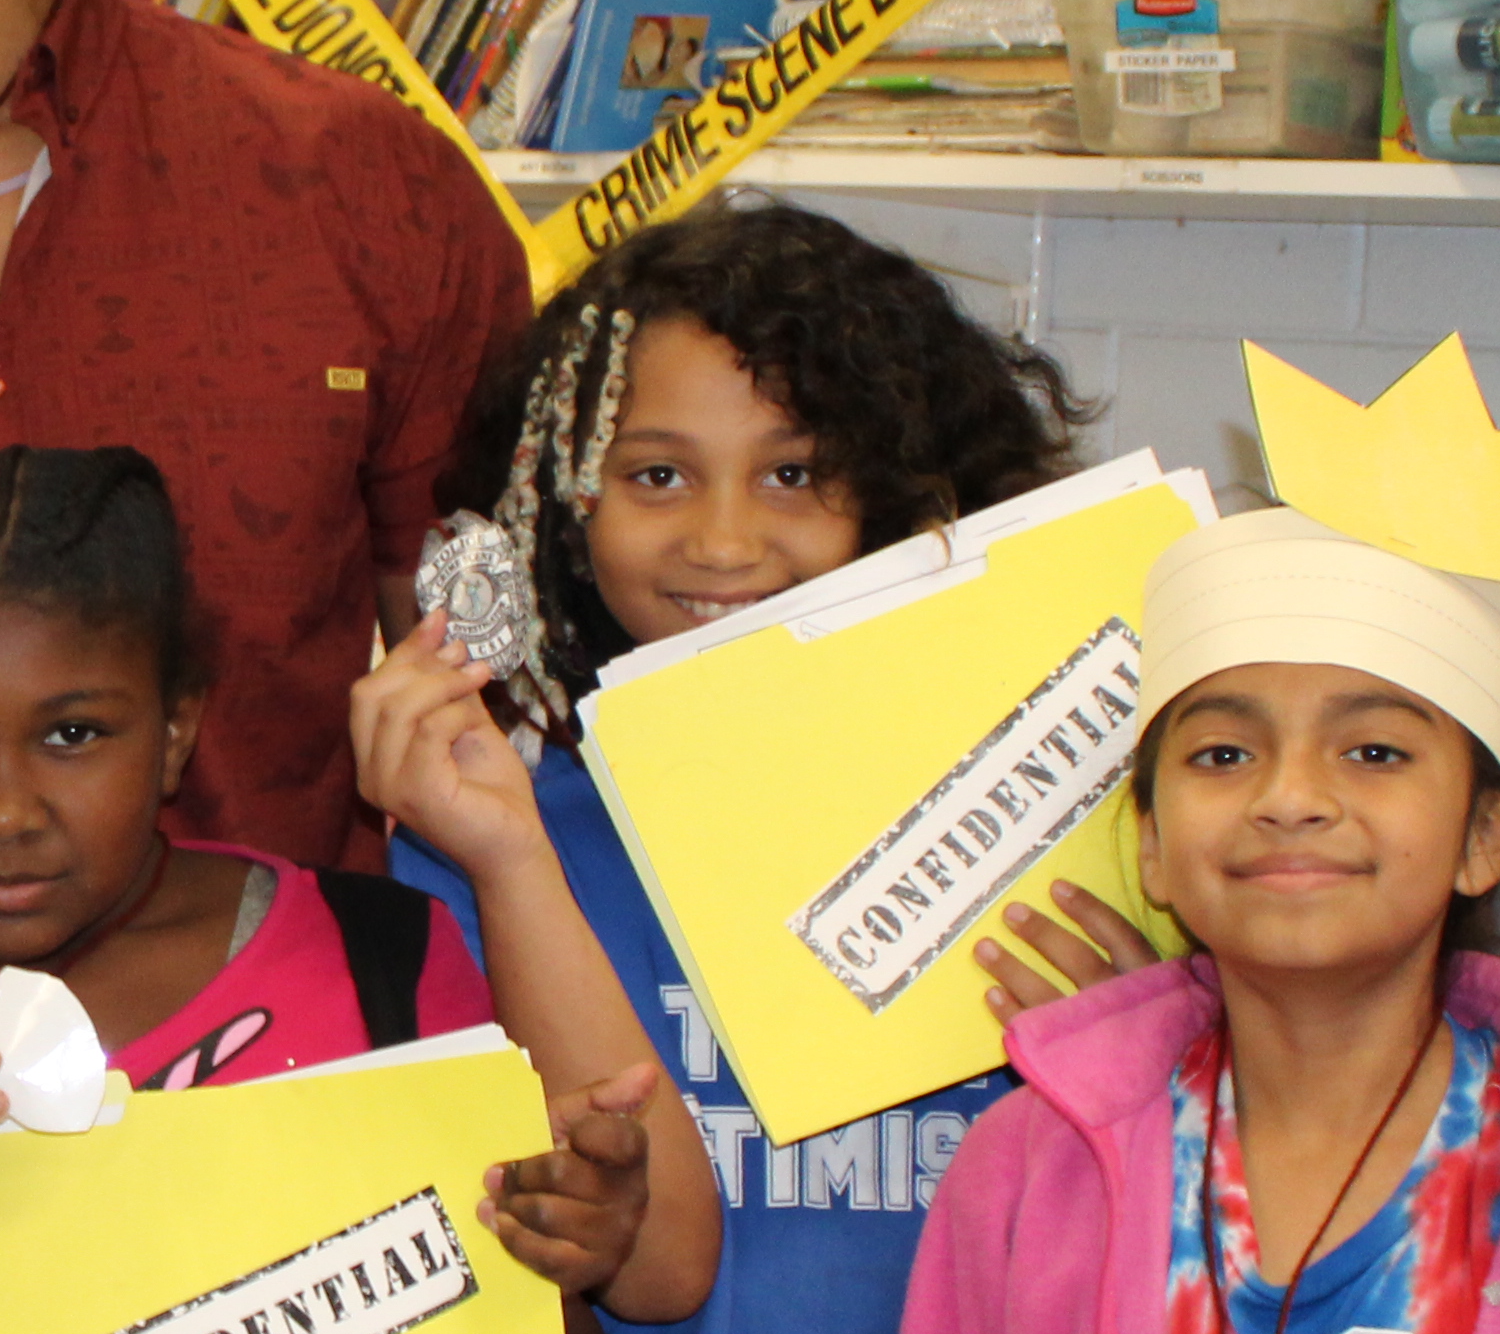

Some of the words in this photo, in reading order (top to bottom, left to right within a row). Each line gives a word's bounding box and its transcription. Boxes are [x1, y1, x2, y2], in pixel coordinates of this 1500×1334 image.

[1118, 55, 1170, 66] STICKER
[1176, 54, 1219, 66] PAPER
[575, 109, 721, 255] CRIME
